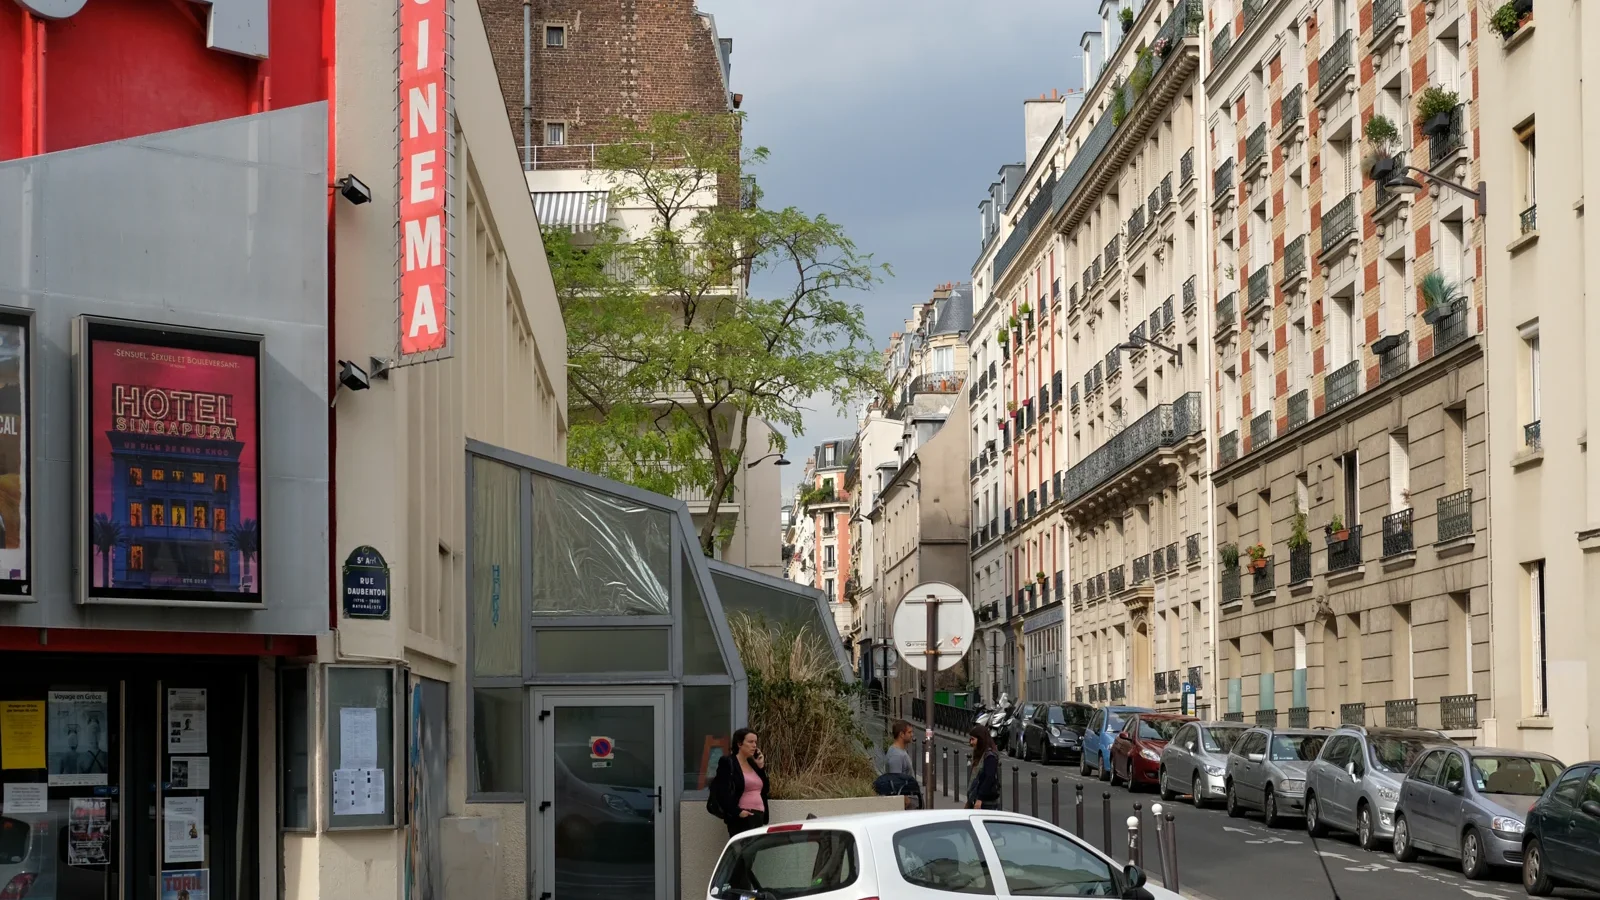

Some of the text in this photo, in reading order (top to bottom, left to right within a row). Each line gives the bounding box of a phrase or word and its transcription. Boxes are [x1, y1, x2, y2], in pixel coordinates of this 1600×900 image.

[405, 0, 441, 337] INEMA
[151, 352, 176, 363] SEXUEL
[115, 385, 237, 426] HOTEL
[116, 416, 235, 440] SINGAPURA
[348, 588, 386, 596] DAUBENTON
[164, 876, 203, 891] TORIL
